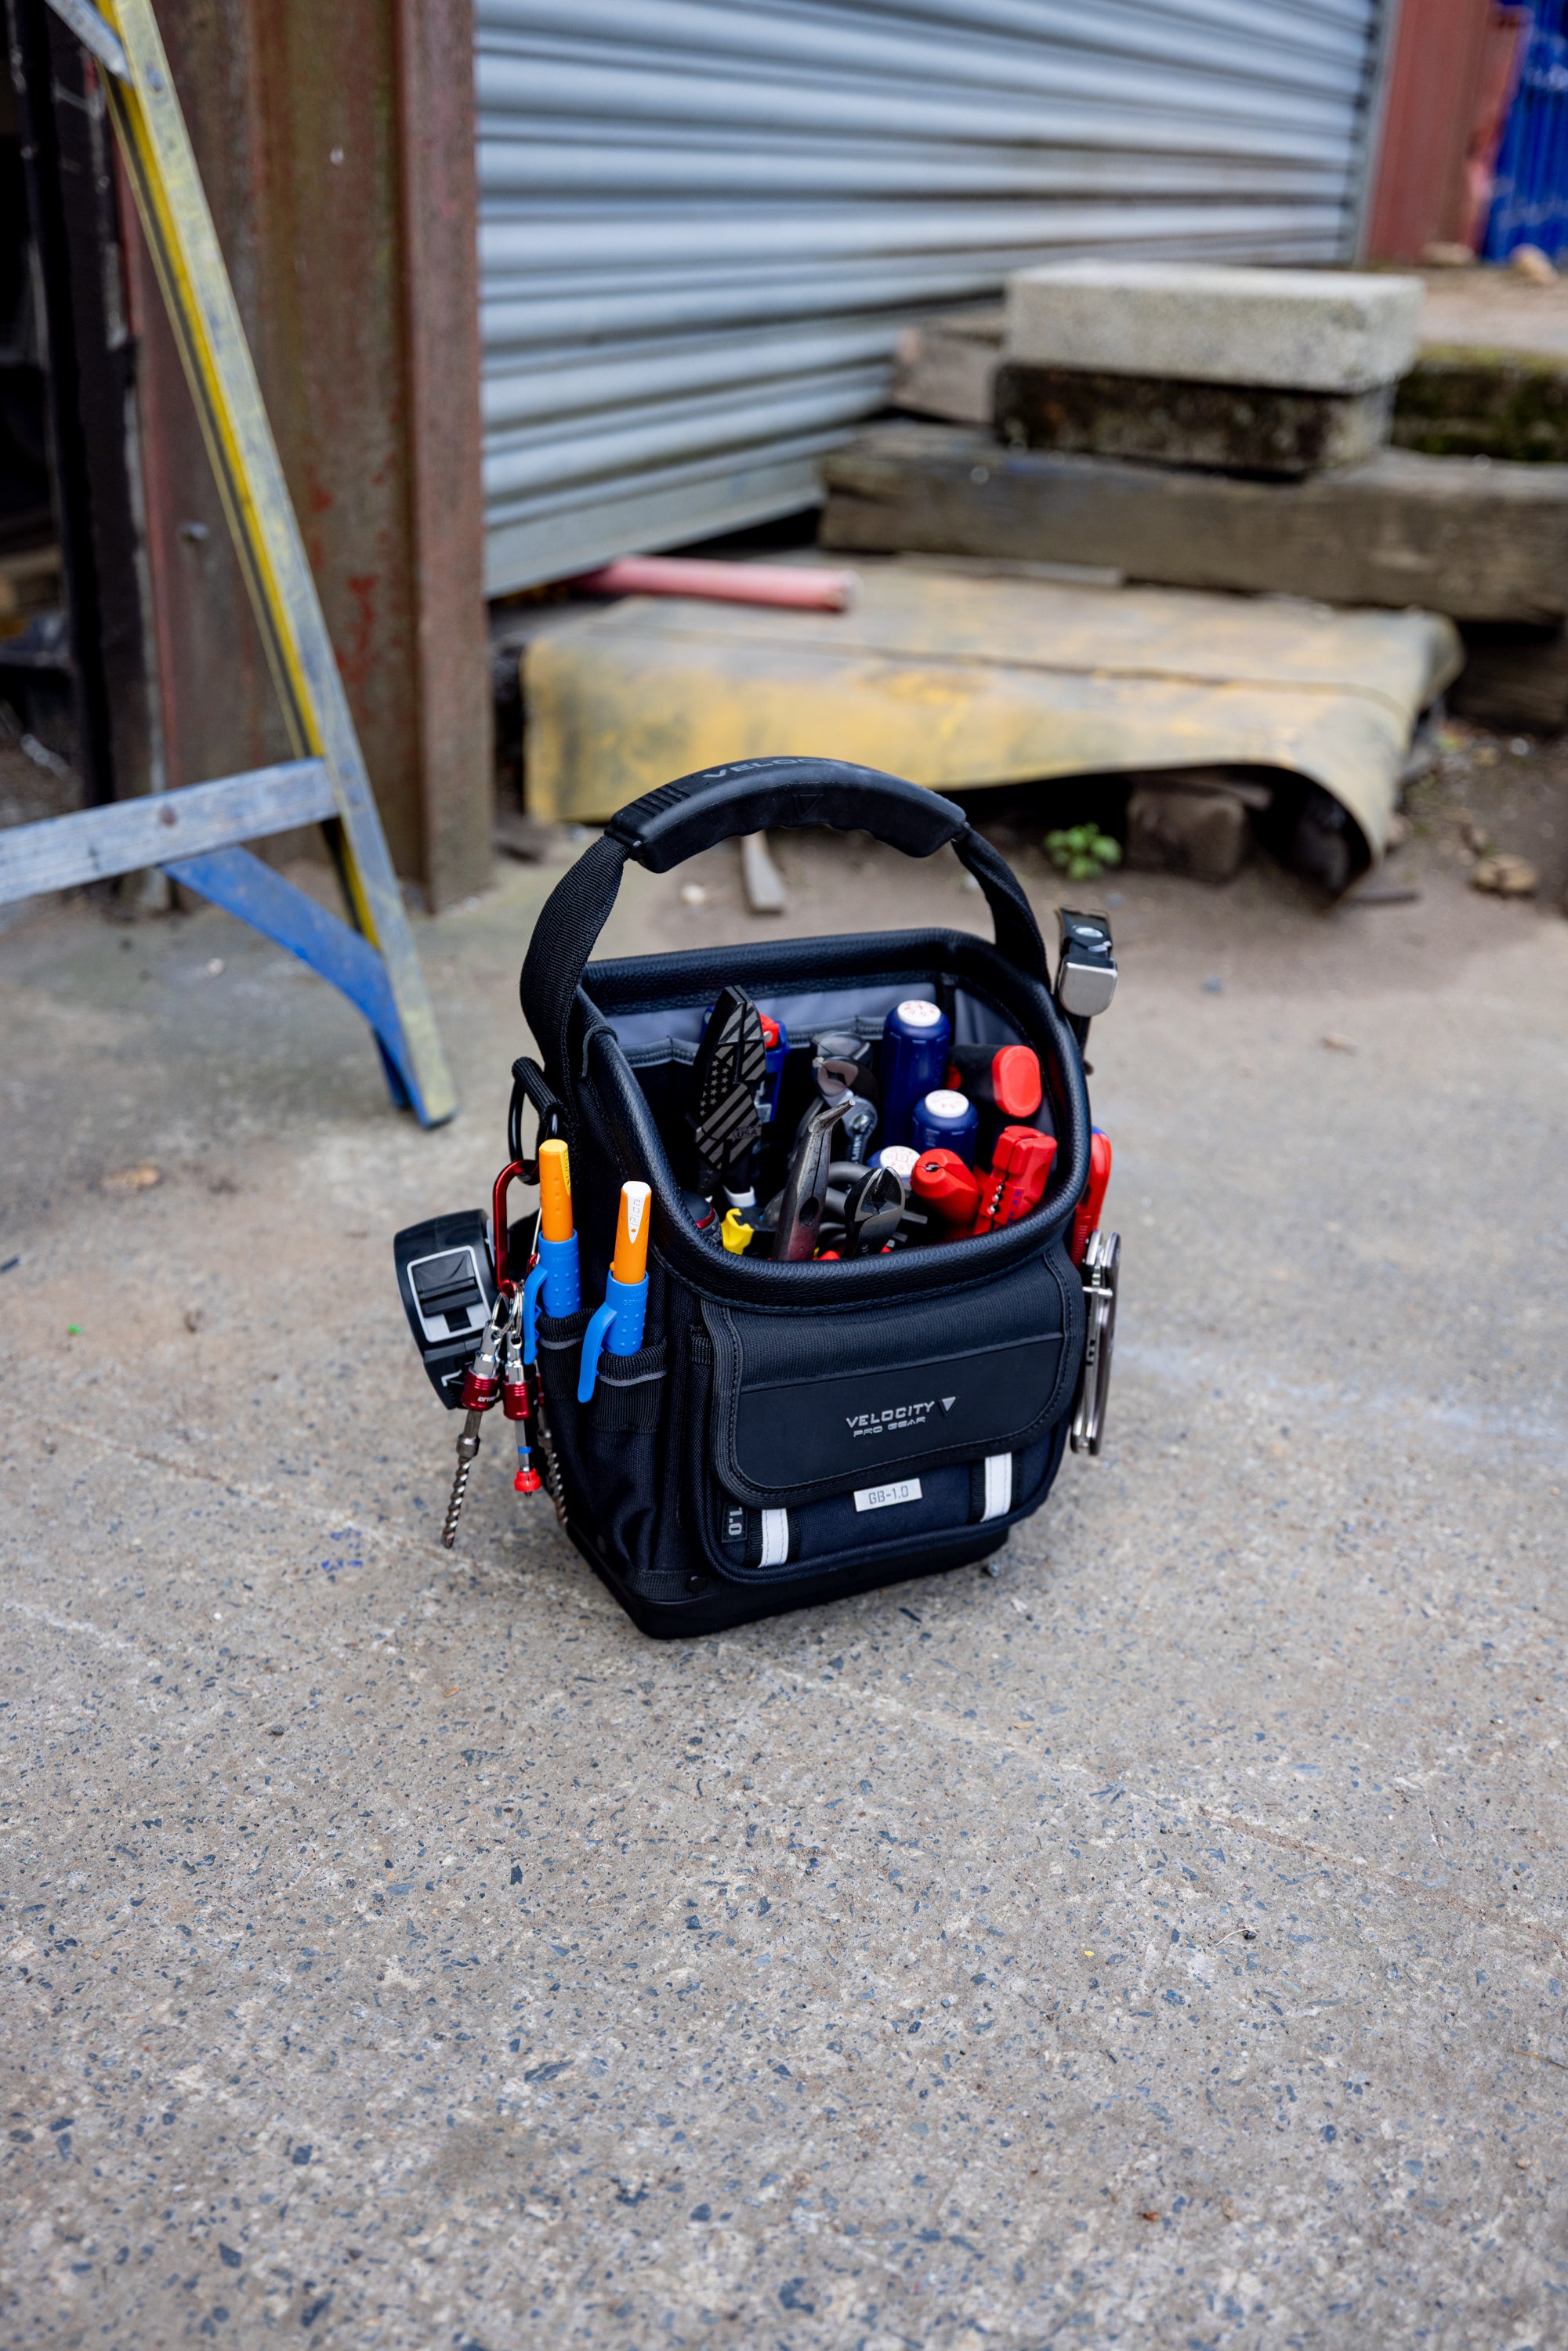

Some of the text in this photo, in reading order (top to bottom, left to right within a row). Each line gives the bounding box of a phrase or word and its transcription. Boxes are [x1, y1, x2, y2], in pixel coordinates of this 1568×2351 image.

[737, 1128, 758, 1138] USA
[846, 1400, 935, 1429] VELOCITY
[853, 1416, 926, 1437] PRO GEAR
[868, 1485, 909, 1505] GB-1.0
[728, 1506, 743, 1536] 1.0
